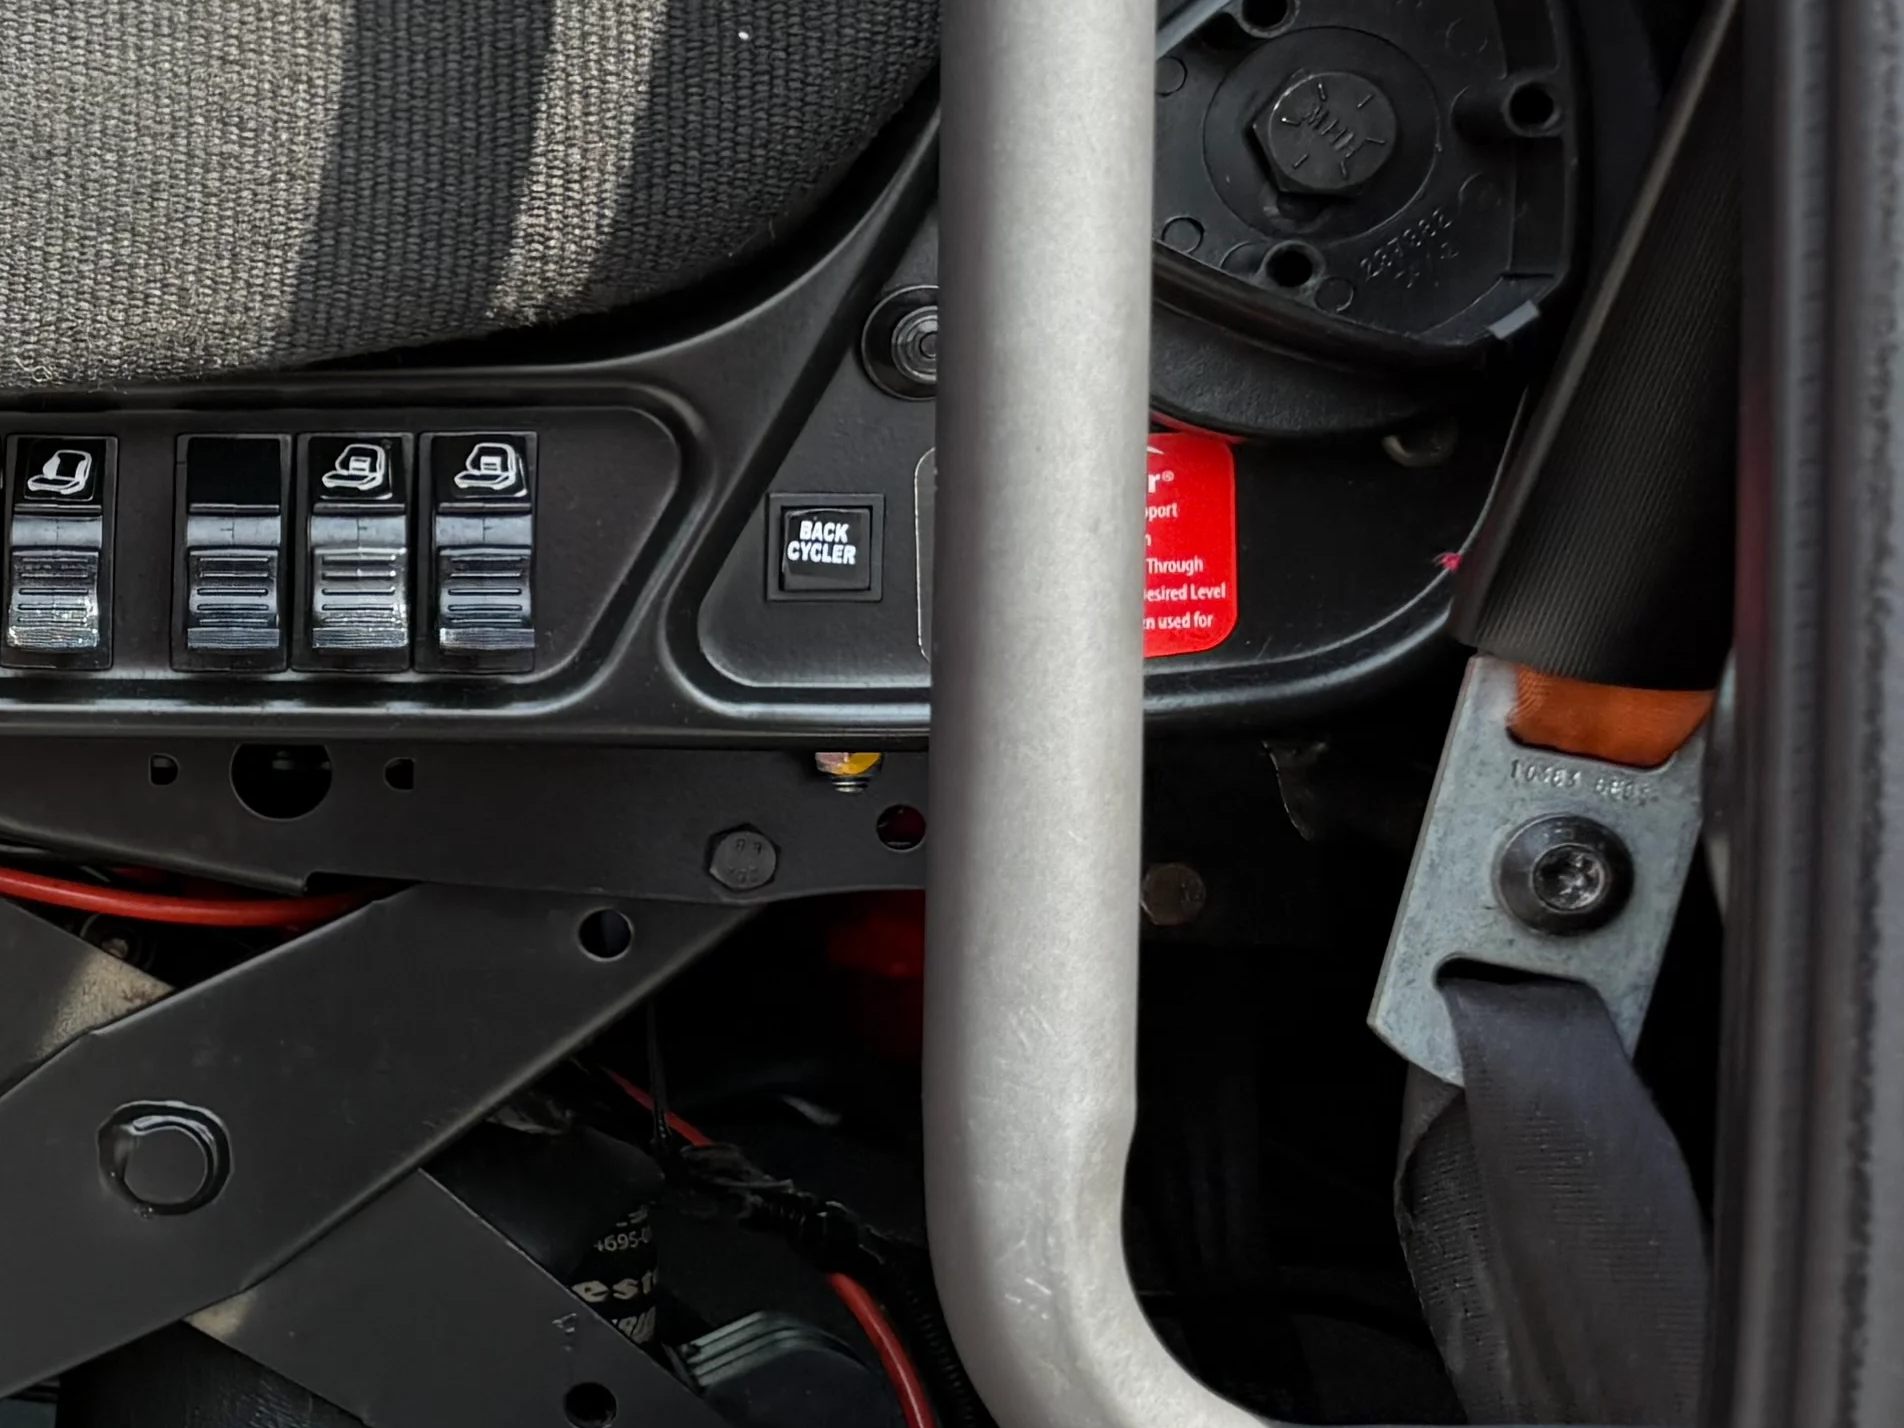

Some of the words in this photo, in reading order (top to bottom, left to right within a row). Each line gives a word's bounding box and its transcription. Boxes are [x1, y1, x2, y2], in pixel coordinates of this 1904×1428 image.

[799, 520, 849, 543] BACK
[787, 541, 857, 566] CYCLER
[1146, 556, 1204, 577] Through
[1144, 583, 1188, 602] esired
[1190, 582, 1227, 600] Level
[1157, 613, 1191, 631] used
[1193, 611, 1214, 629] for
